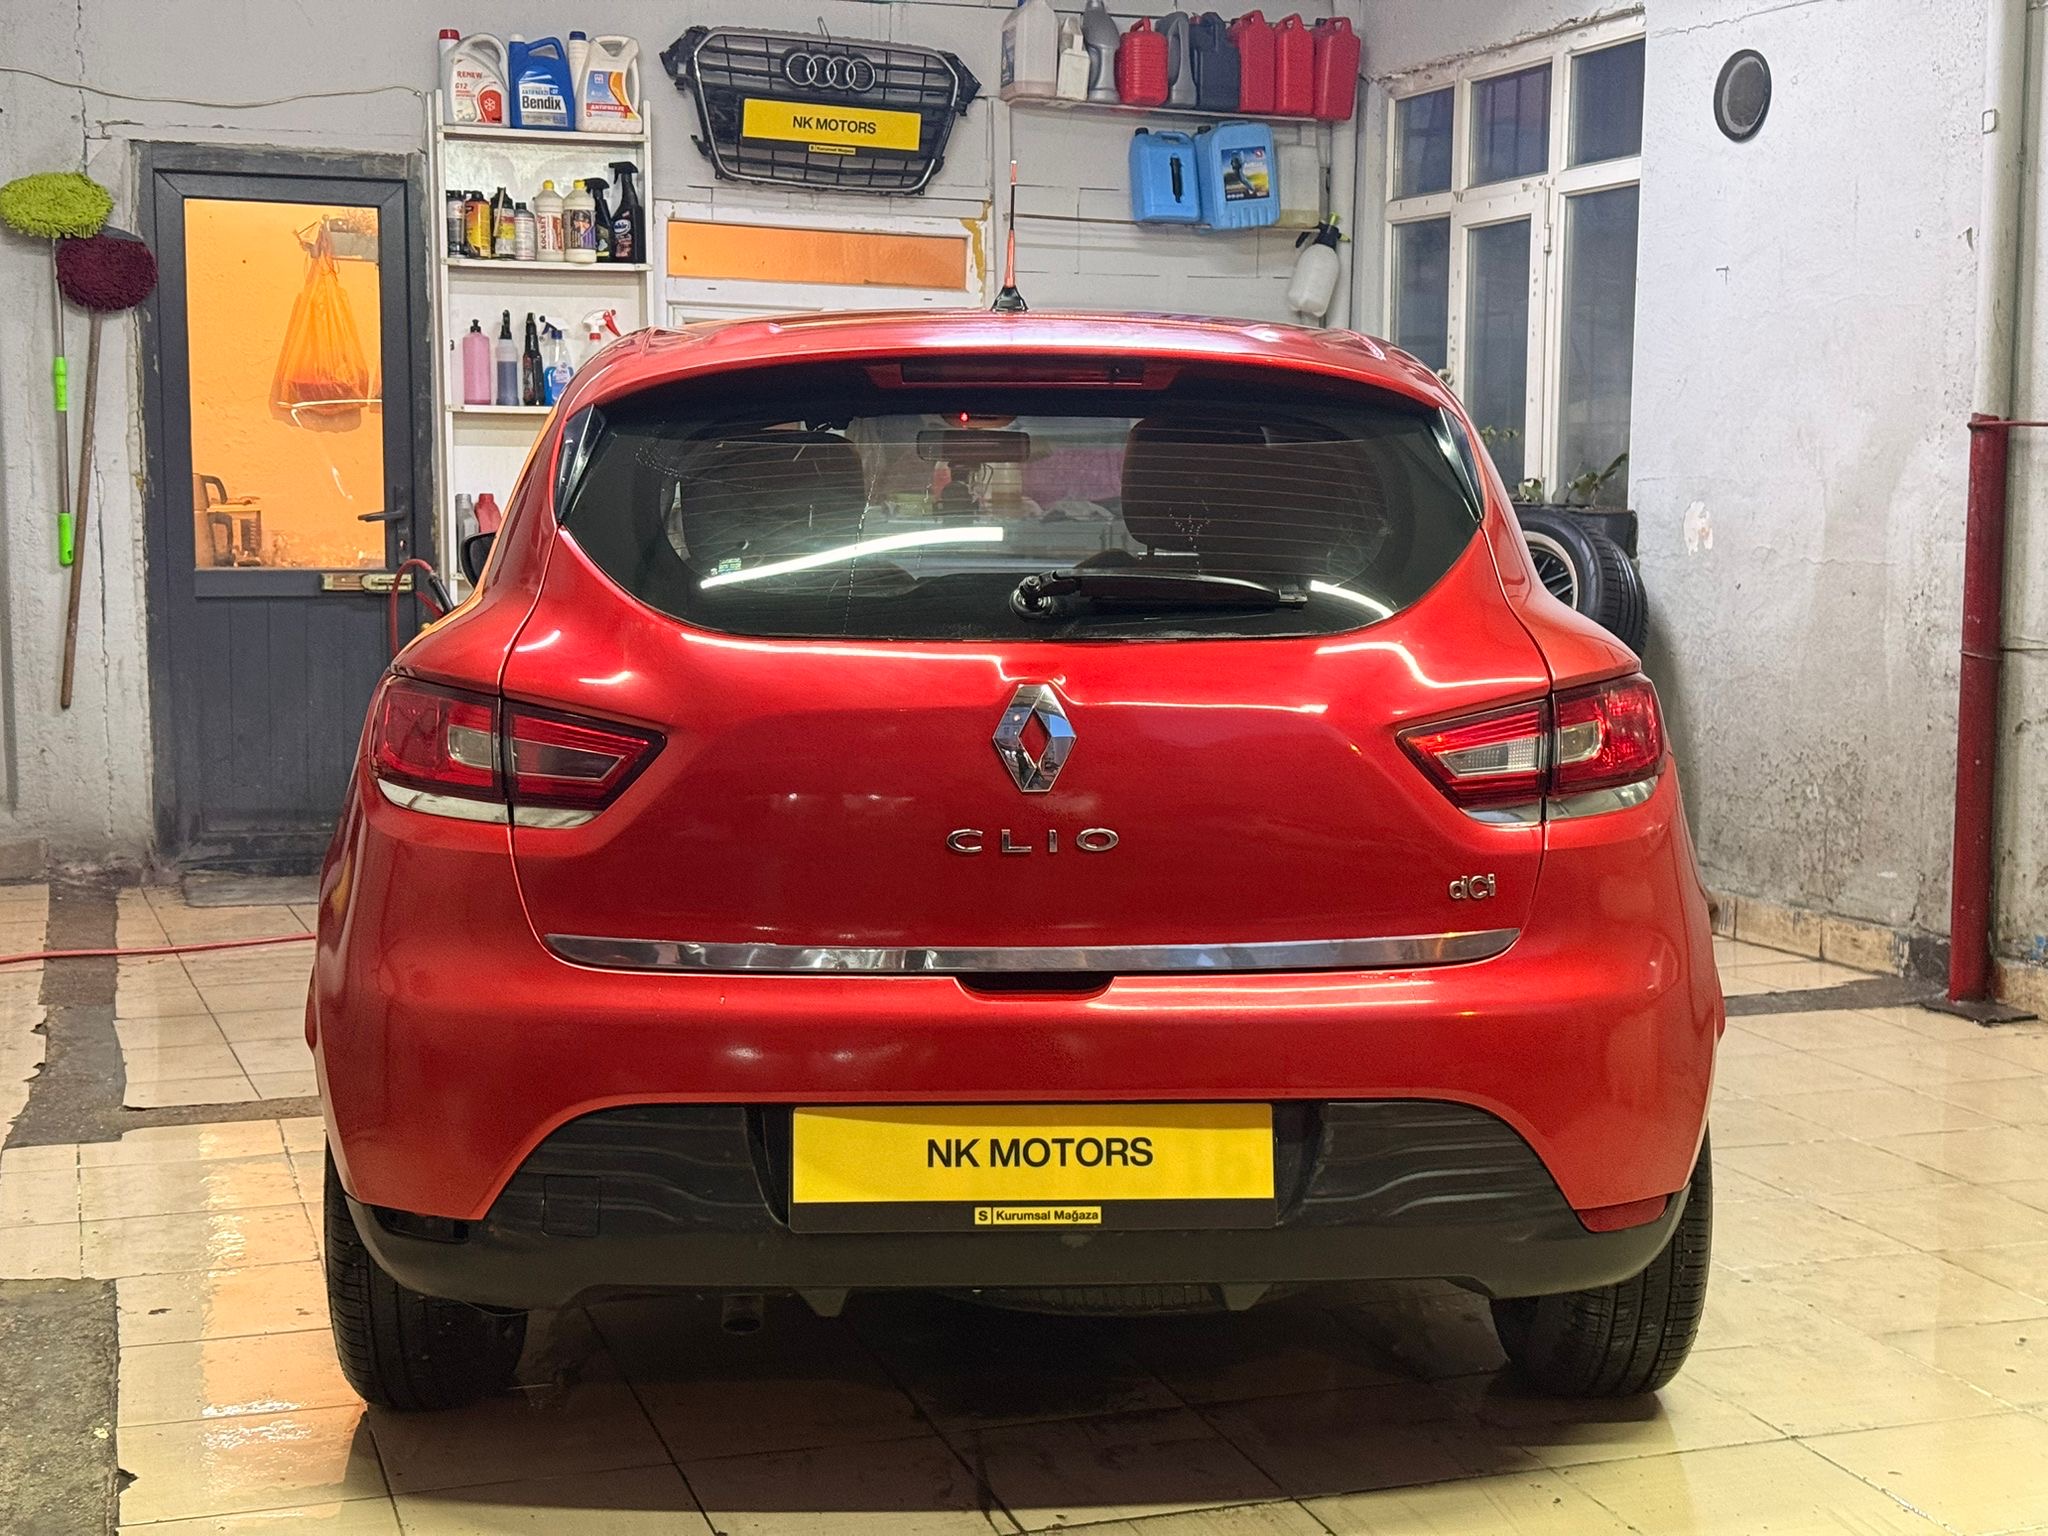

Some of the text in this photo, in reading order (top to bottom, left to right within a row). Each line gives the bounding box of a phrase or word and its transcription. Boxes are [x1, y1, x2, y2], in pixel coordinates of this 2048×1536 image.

[522, 95, 562, 110] Bendix
[793, 116, 877, 135] NK MOTORS
[946, 828, 1120, 852] CLIO
[1449, 873, 1496, 899] dCi
[927, 1137, 1154, 1168] NK MOTORS
[978, 1210, 1099, 1223] S Kurumsal Mağaza
